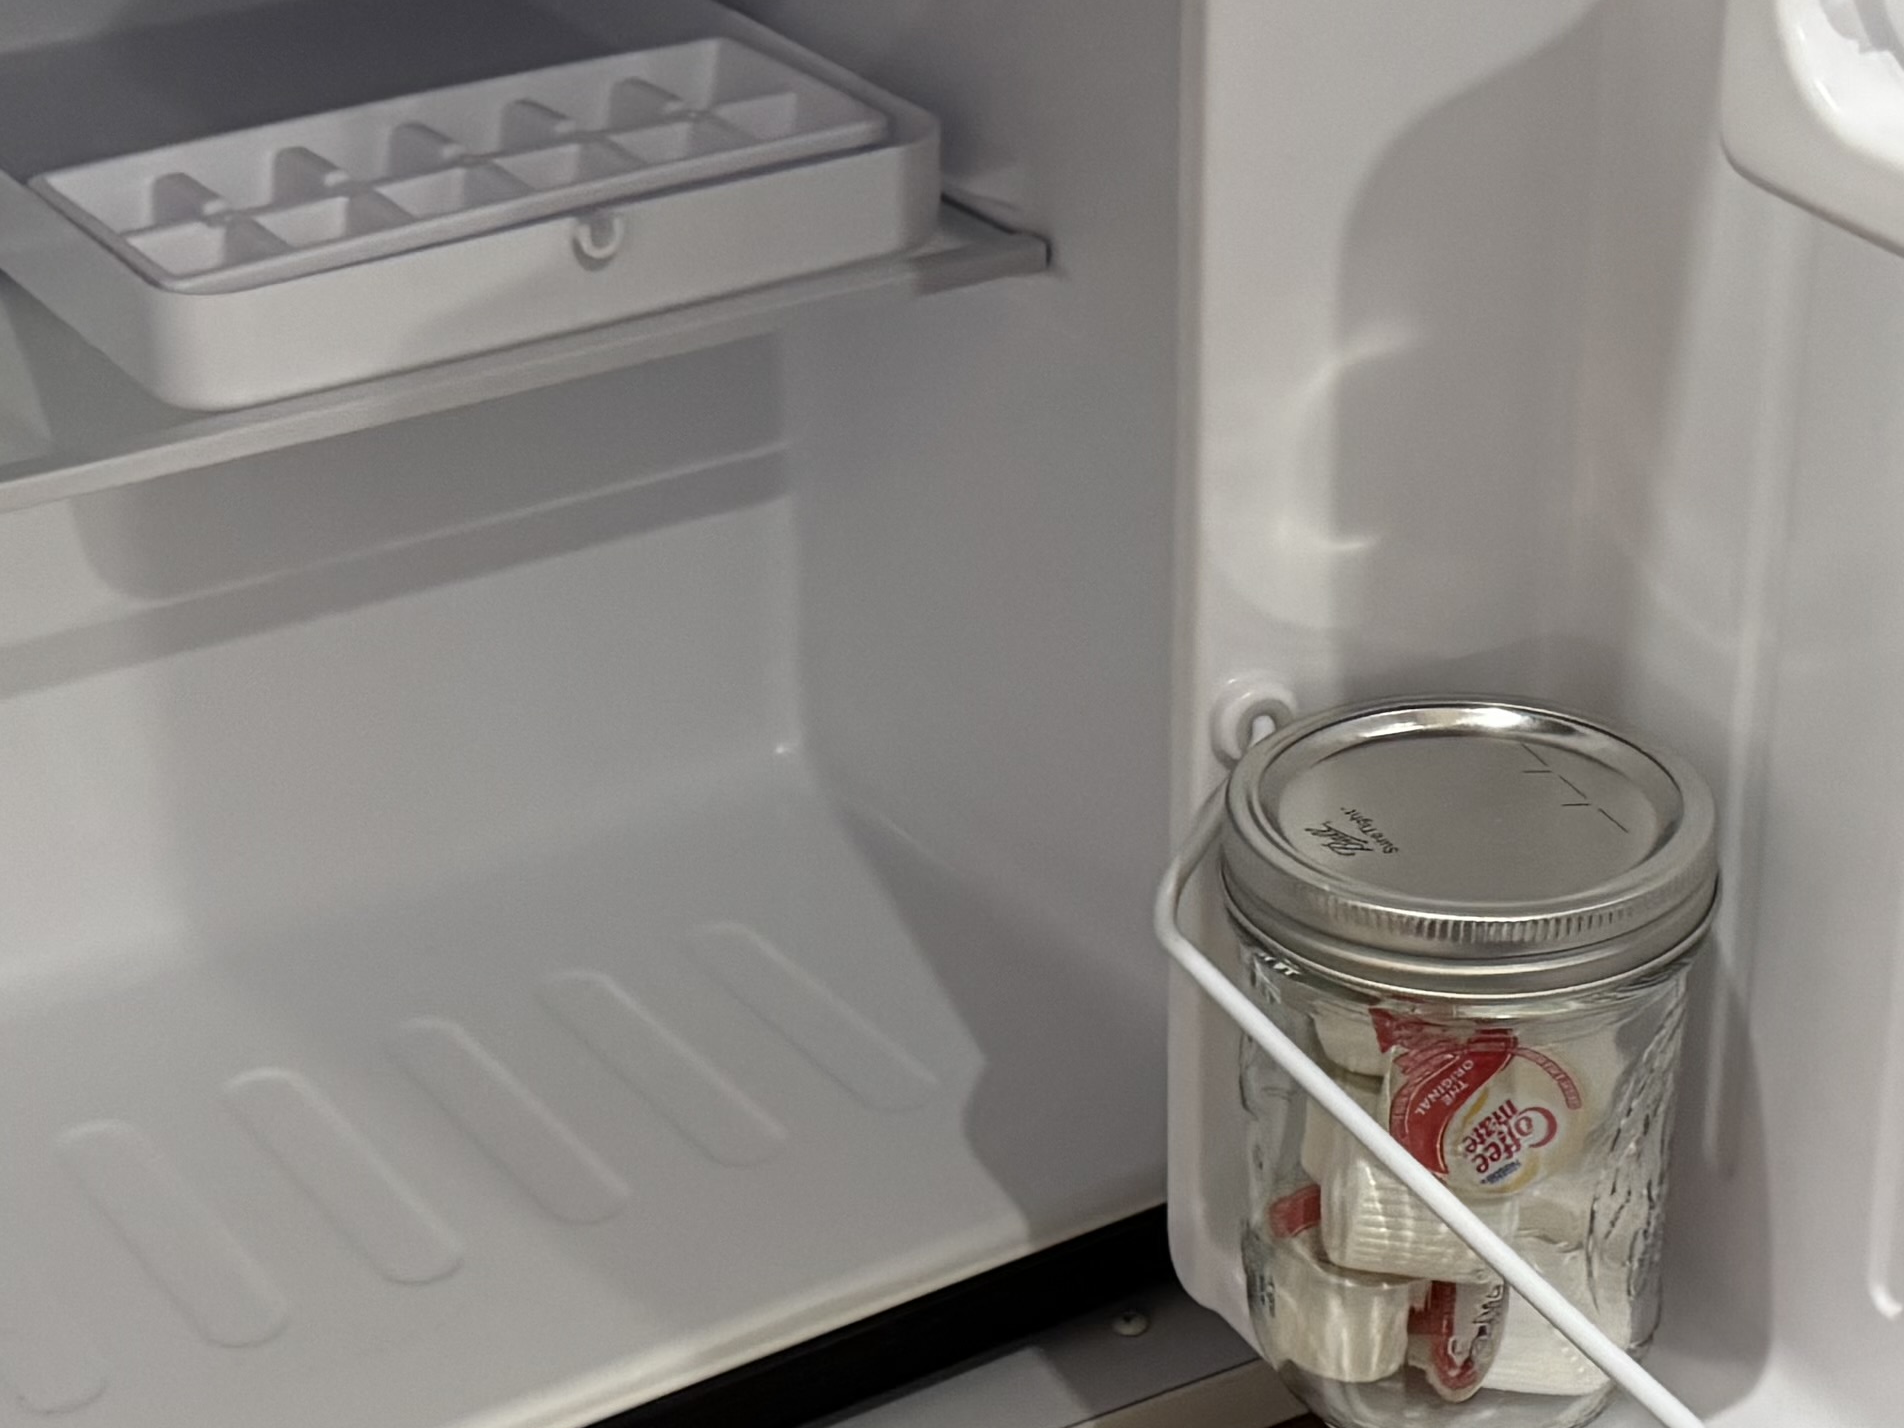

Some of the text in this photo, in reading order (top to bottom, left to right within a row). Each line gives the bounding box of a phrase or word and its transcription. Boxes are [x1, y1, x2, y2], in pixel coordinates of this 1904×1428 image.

[1413, 1059, 1475, 1117] ORIGINAL
[1440, 1079, 1469, 1107] THE
[1471, 1106, 1558, 1174] Coffee
